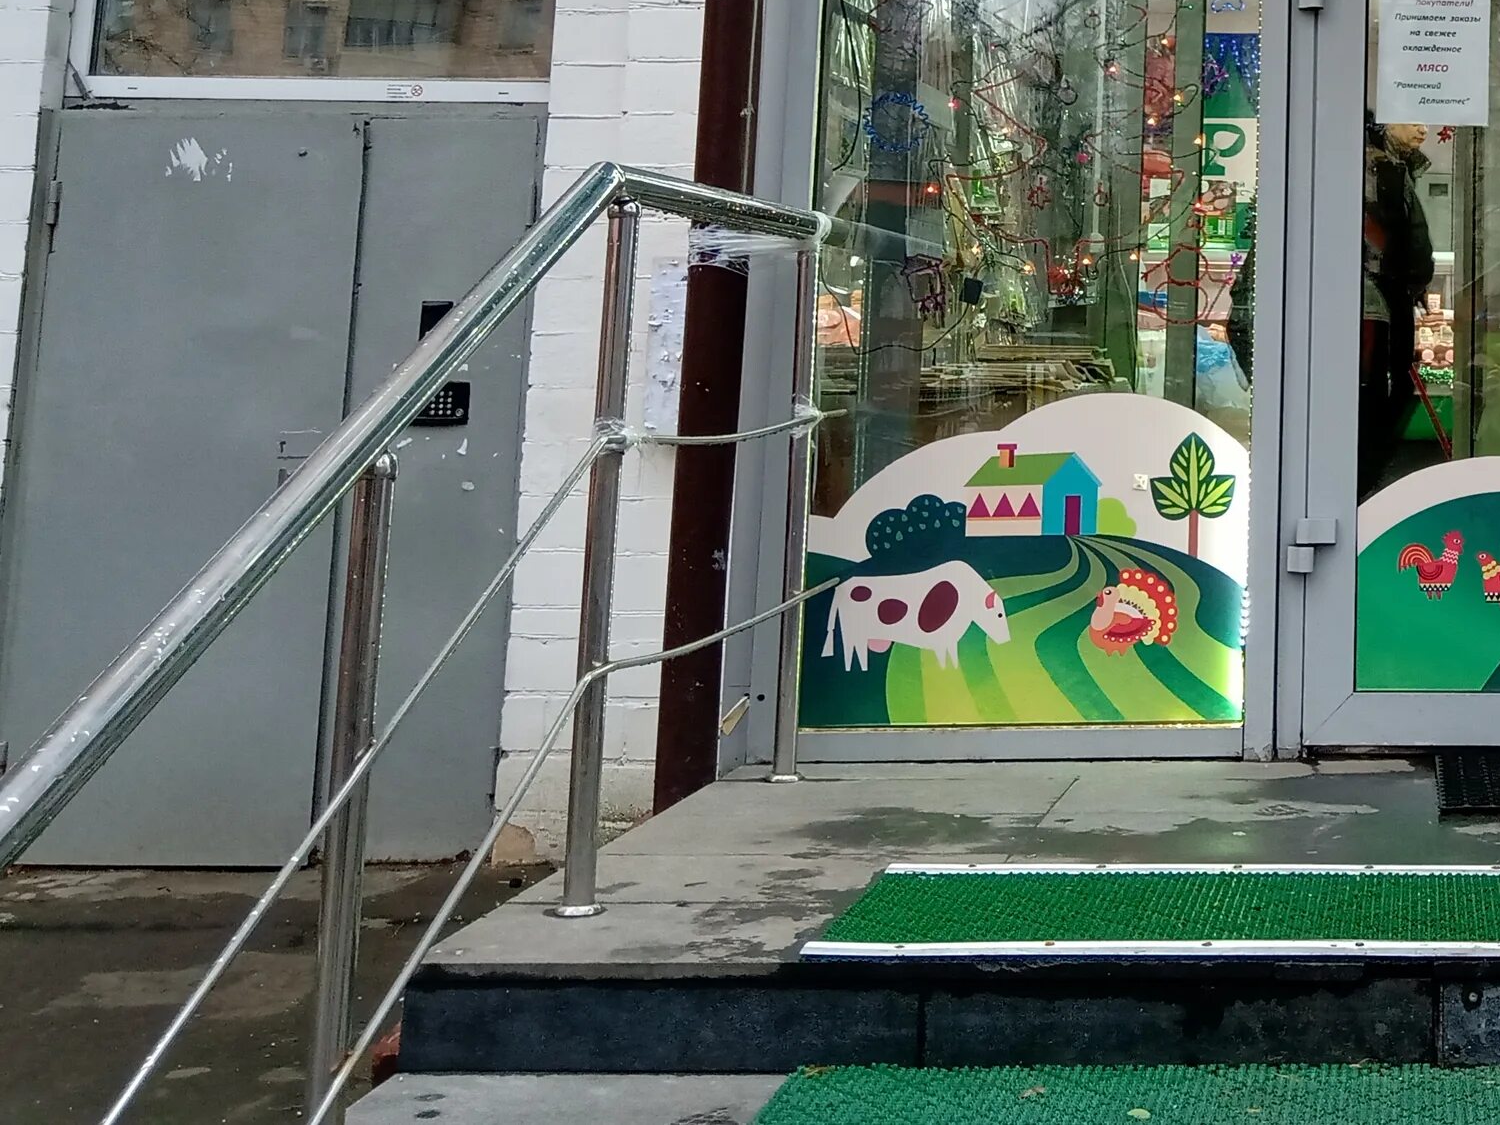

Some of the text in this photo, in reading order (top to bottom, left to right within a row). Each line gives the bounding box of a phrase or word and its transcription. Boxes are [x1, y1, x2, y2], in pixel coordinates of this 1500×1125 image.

[1415, 0, 1474, 7] покупатели!
[1395, 13, 1446, 22] Принимаем
[1402, 44, 1463, 53] охлажденное
[1416, 63, 1449, 73] МЯСО
